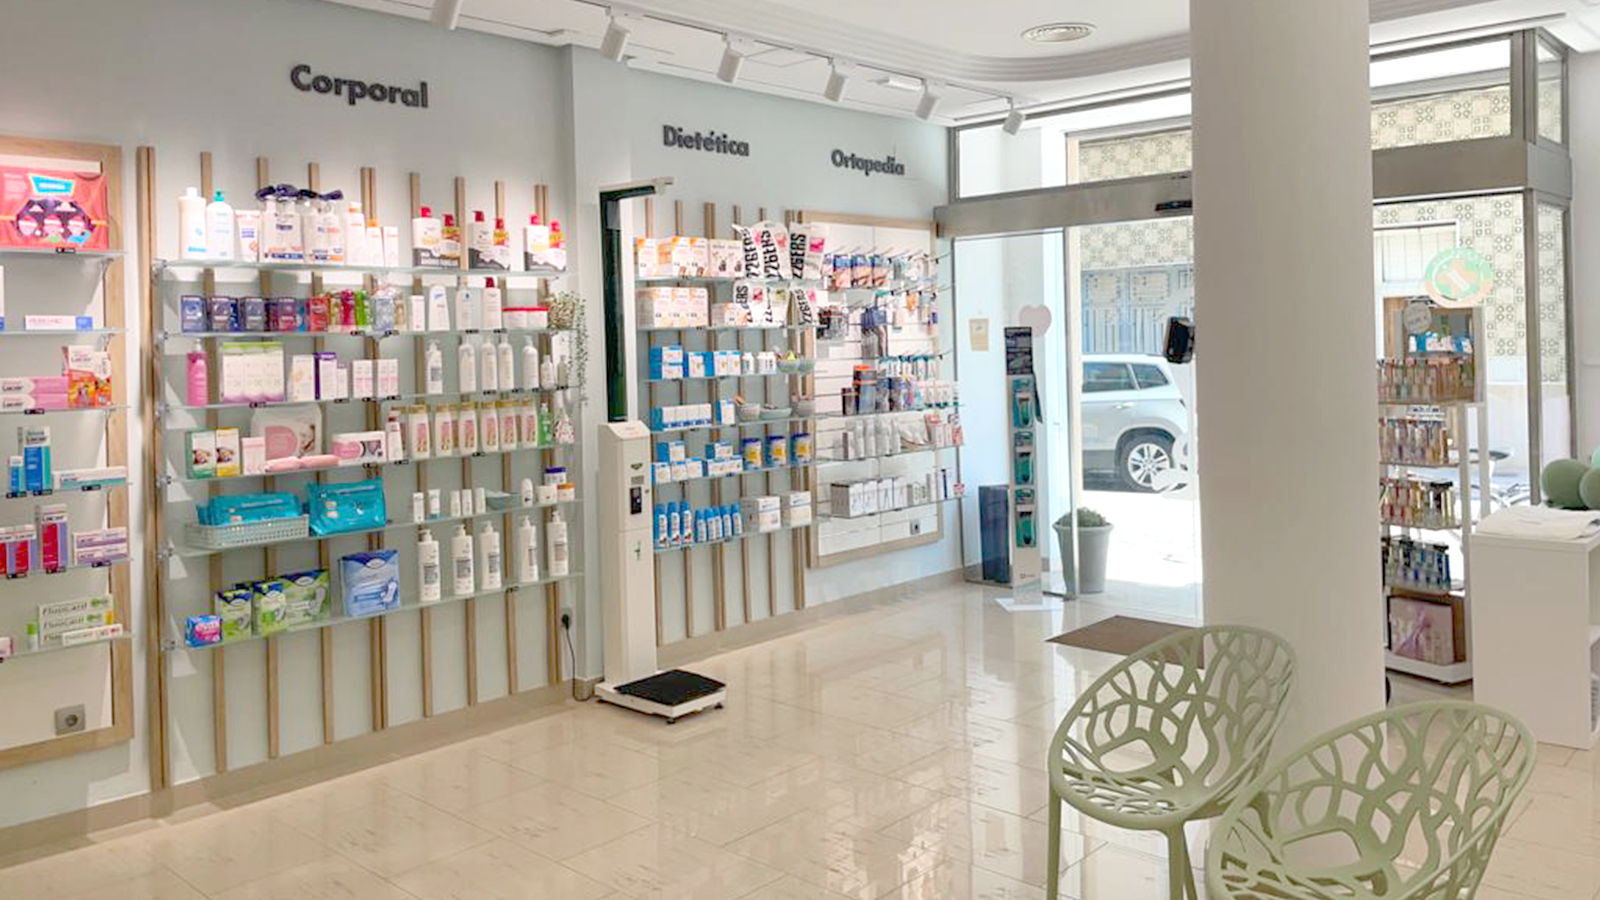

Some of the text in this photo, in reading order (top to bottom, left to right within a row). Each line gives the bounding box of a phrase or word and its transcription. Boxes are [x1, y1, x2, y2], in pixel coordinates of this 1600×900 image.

[290, 64, 428, 108] Corporal
[663, 125, 750, 157] Dietética
[831, 149, 905, 176] Ortopedia
[790, 233, 806, 279] 226ERS
